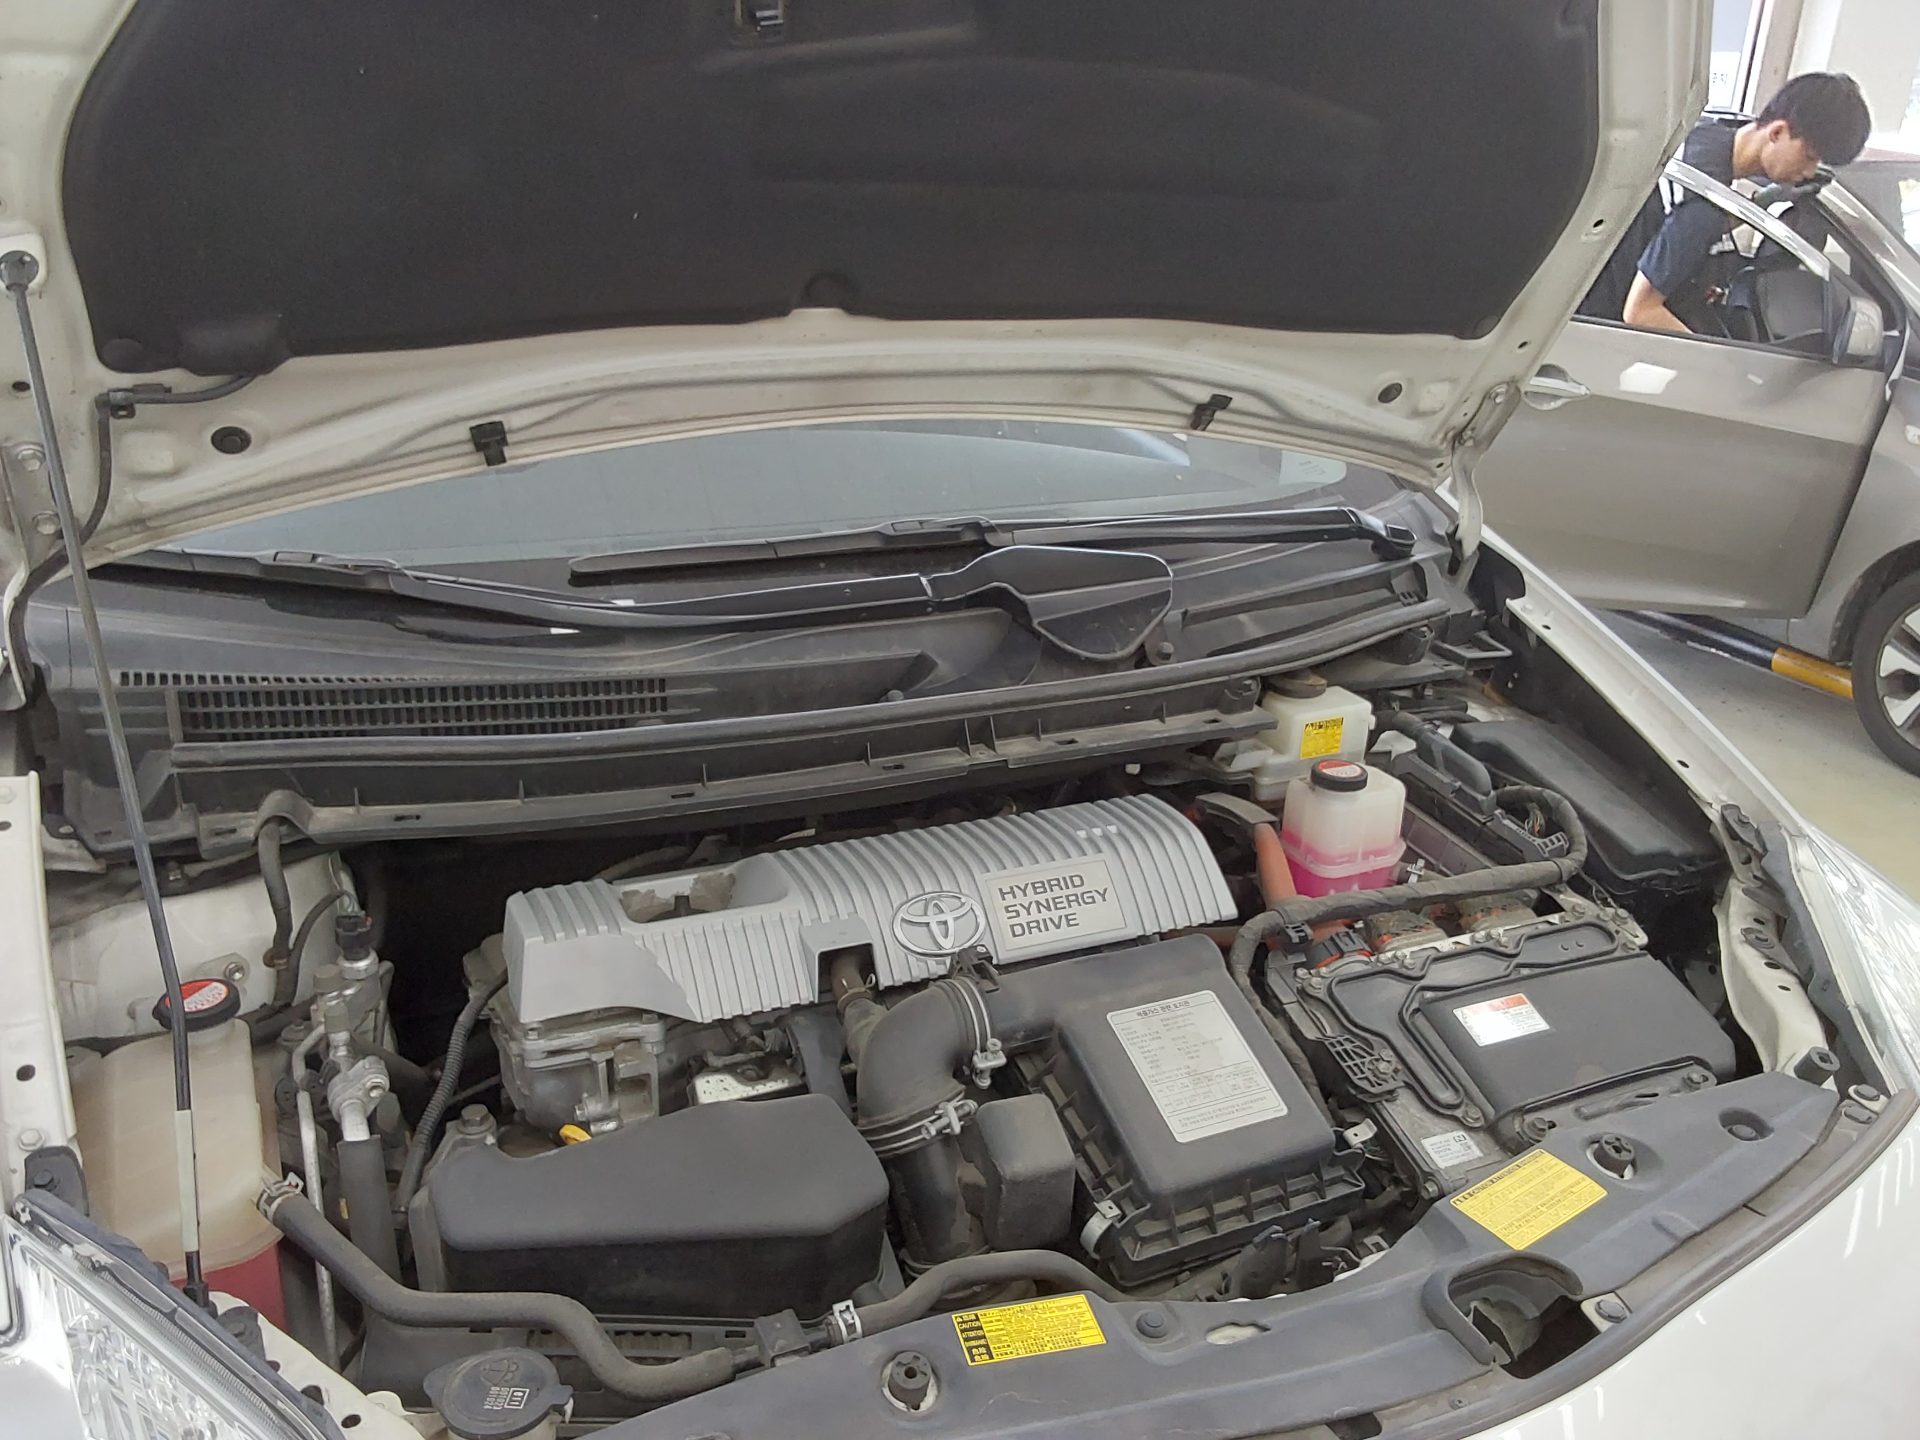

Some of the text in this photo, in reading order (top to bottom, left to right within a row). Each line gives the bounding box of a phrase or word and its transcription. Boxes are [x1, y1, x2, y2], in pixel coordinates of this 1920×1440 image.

[998, 874, 1085, 901] HYBRID
[1004, 887, 1108, 920] SYNERGY
[1009, 912, 1080, 938] DRIVE
[958, 1321, 982, 1329] CAUTION
